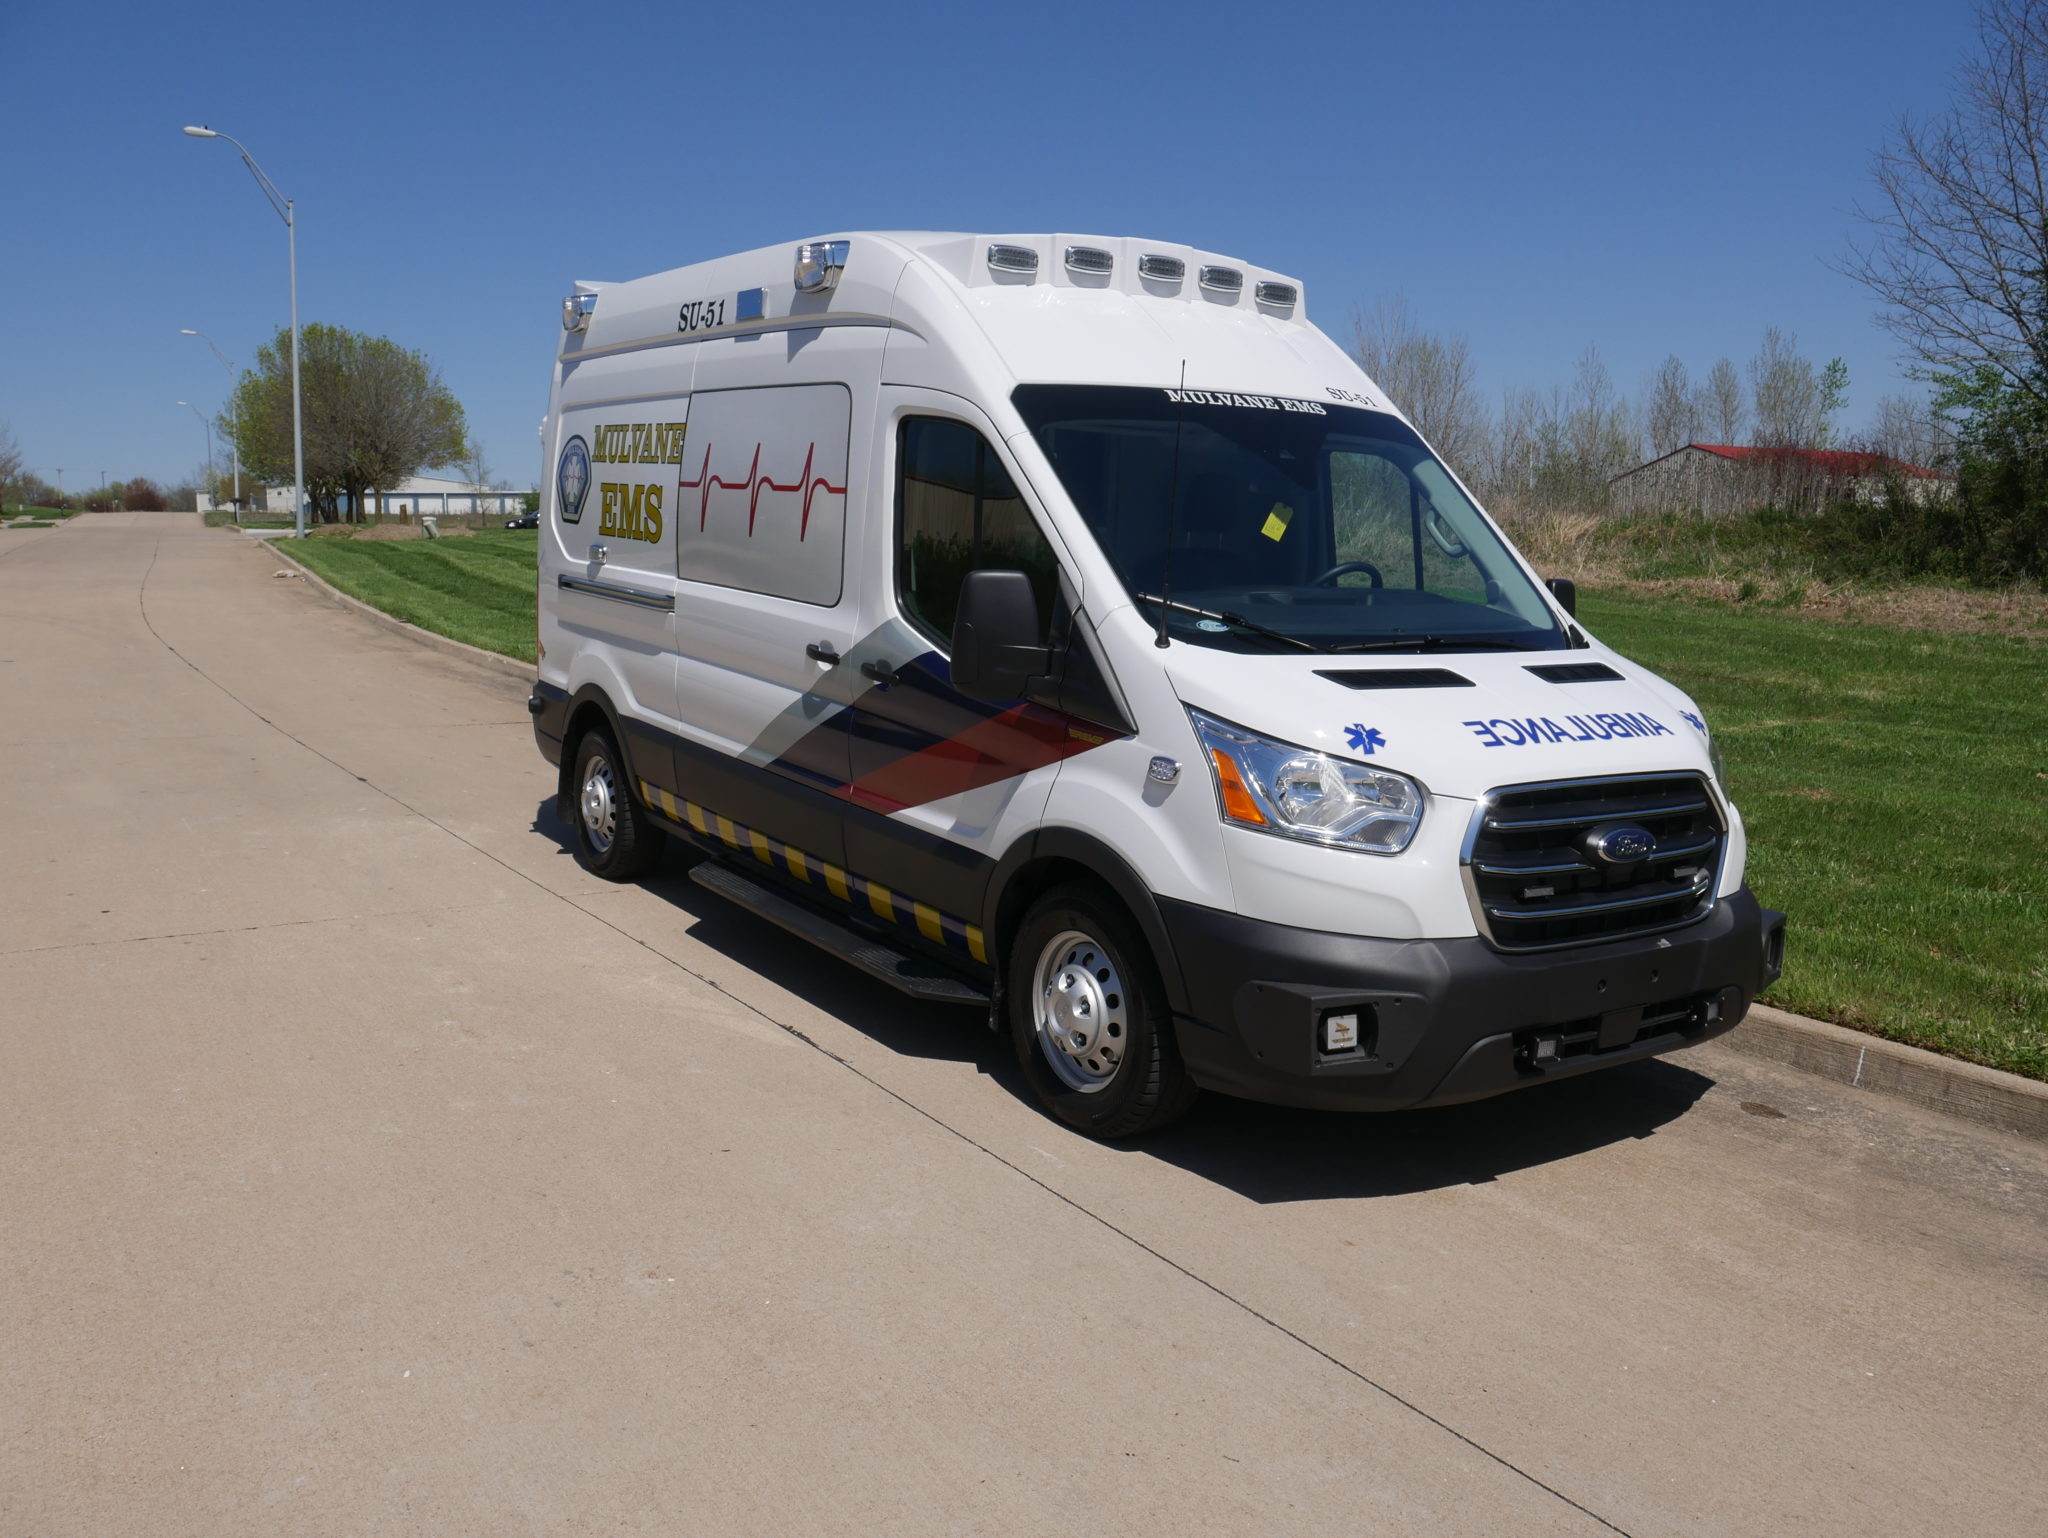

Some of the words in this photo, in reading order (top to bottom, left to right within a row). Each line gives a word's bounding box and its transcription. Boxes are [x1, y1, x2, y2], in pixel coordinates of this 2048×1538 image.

[678, 299, 725, 332] SU-51
[1164, 389, 1274, 410] MULVANE
[1277, 398, 1327, 416] EMS
[1325, 387, 1378, 407] SU-51
[592, 423, 687, 464] MULVANE
[599, 483, 663, 544] EMS
[1616, 834, 1648, 856] Ford
